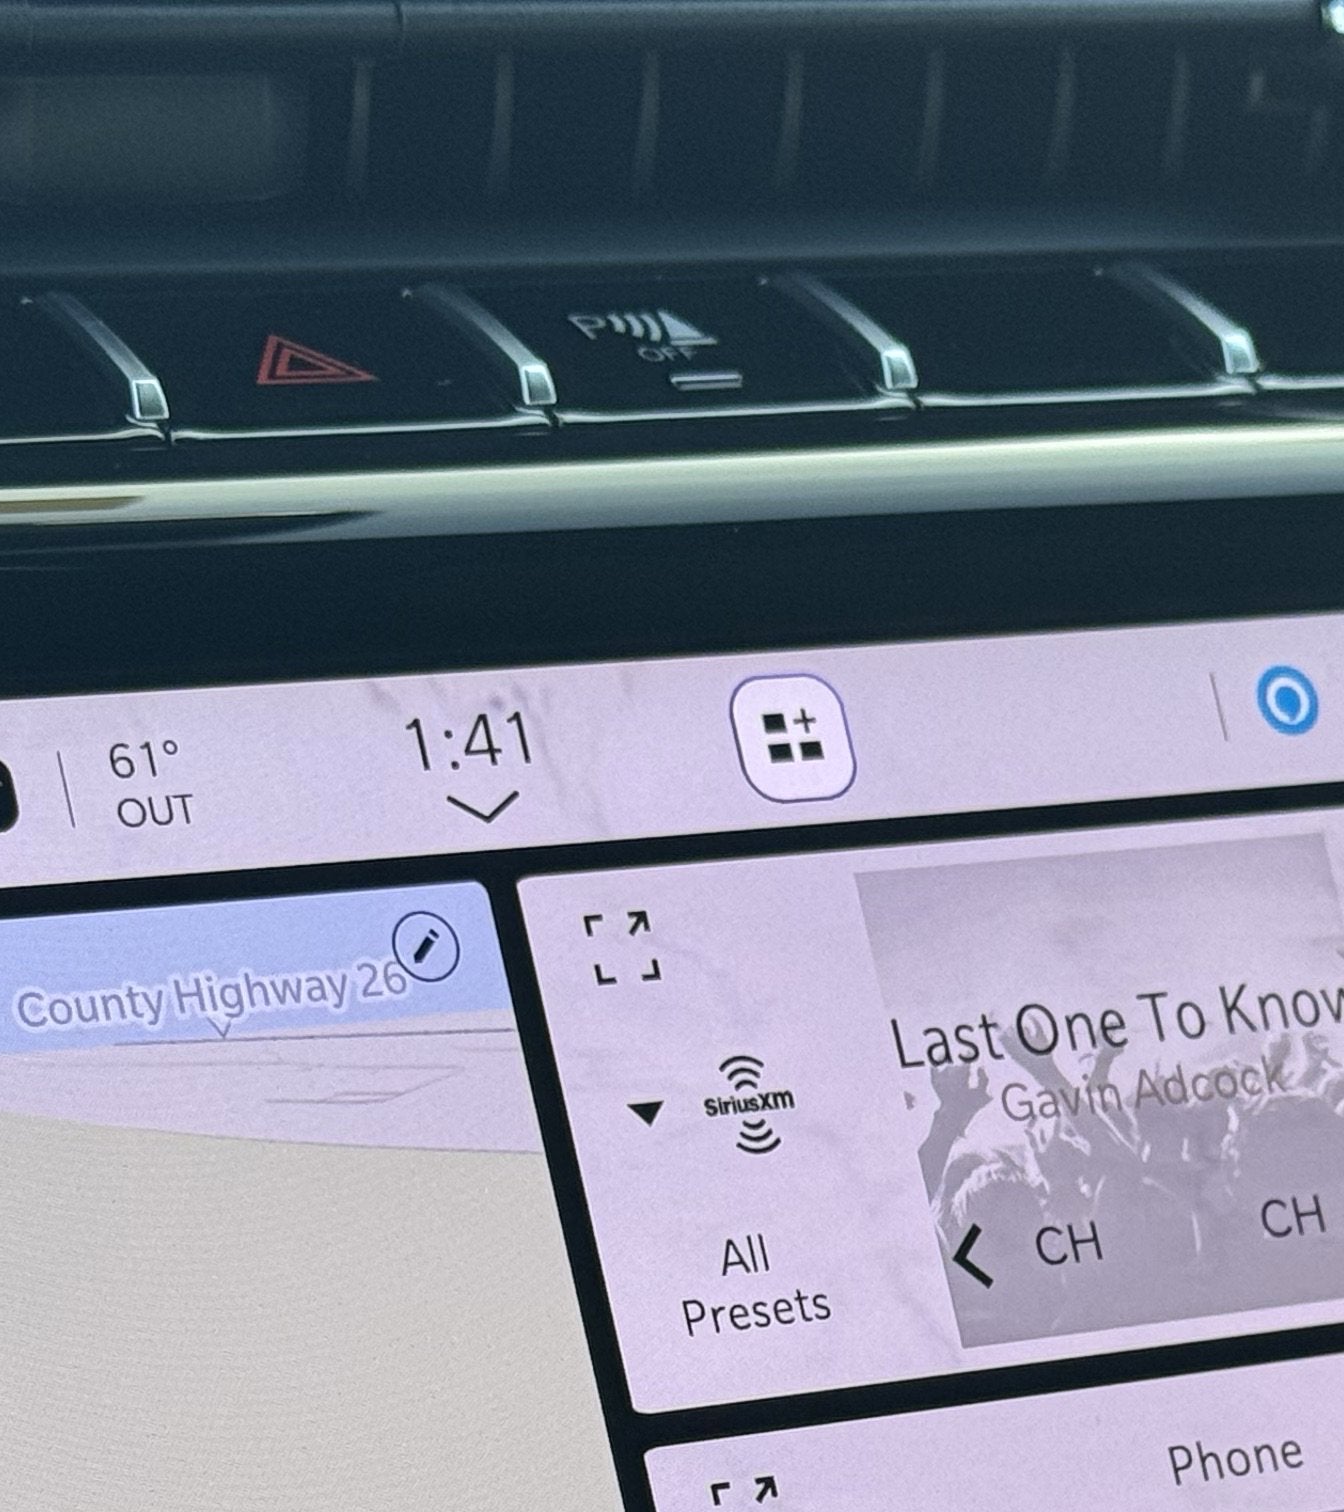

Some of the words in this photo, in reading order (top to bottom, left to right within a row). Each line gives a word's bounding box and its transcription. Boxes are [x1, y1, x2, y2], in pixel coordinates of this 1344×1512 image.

[638, 347, 697, 362] OFF
[108, 739, 179, 780] 61°
[404, 710, 533, 772] 1:41
[116, 794, 194, 829] OUT
[17, 985, 162, 1028] County
[174, 968, 348, 1015] Highway
[359, 961, 407, 998] 26
[891, 1015, 1003, 1070] Last
[1014, 1003, 1130, 1057] One
[1136, 990, 1207, 1044] To
[1001, 1074, 1123, 1123] Gavin
[1135, 1056, 1288, 1110] Adcock
[1261, 1193, 1326, 1239] CH
[721, 1234, 770, 1276] All
[1035, 1222, 1104, 1266] CH
[682, 1288, 831, 1337] Presets
[1168, 1436, 1306, 1486] Phone
